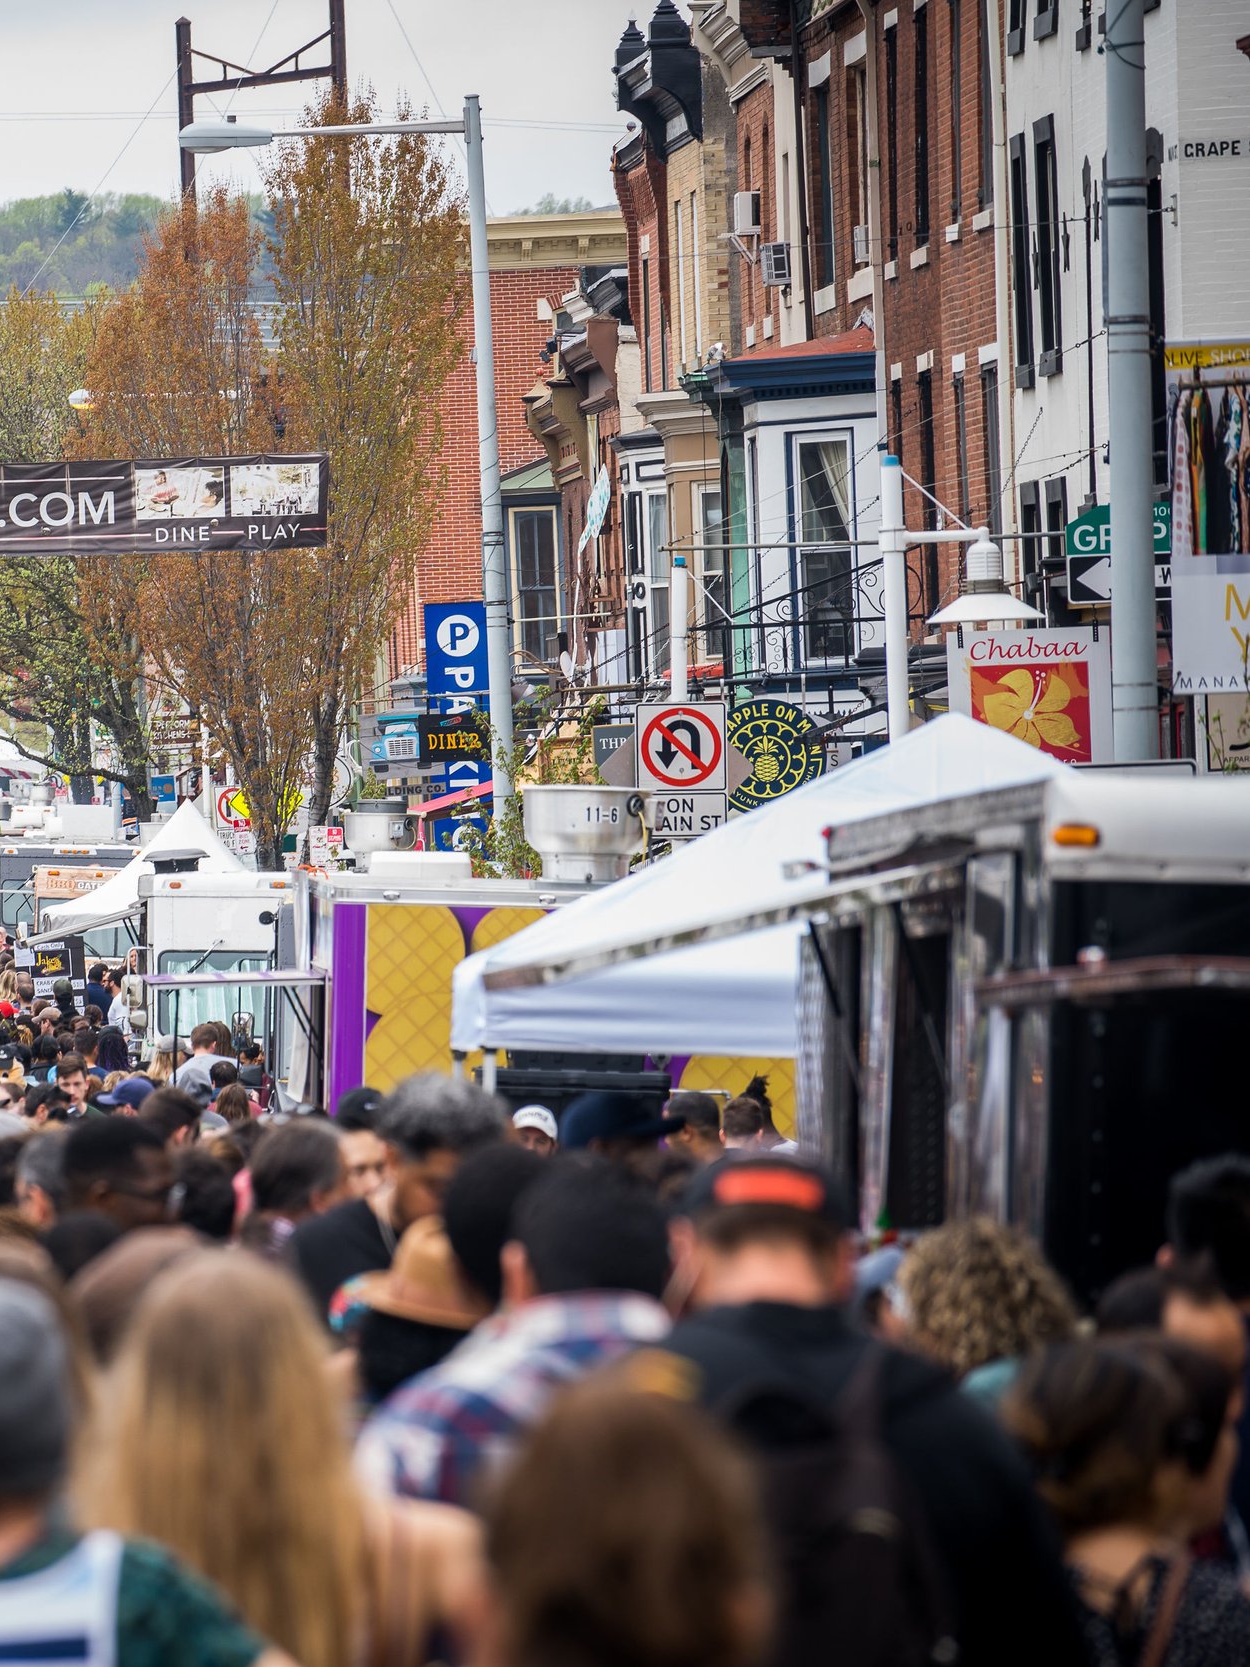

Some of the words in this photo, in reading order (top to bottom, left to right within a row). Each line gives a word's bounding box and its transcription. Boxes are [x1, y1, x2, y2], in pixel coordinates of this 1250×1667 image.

[1184, 140, 1241, 158] GRAPE
[155, 525, 210, 543] DINE
[248, 522, 301, 541] PLAY
[449, 622, 469, 651] P
[970, 636, 1088, 661] Chabaa
[775, 705, 797, 722] ON
[427, 733, 482, 751] DINER
[426, 784, 445, 794] CO.
[586, 806, 618, 823] 11-6
[667, 798, 693, 814] ON
[660, 816, 693, 832] AIN
[700, 815, 722, 831] ST
